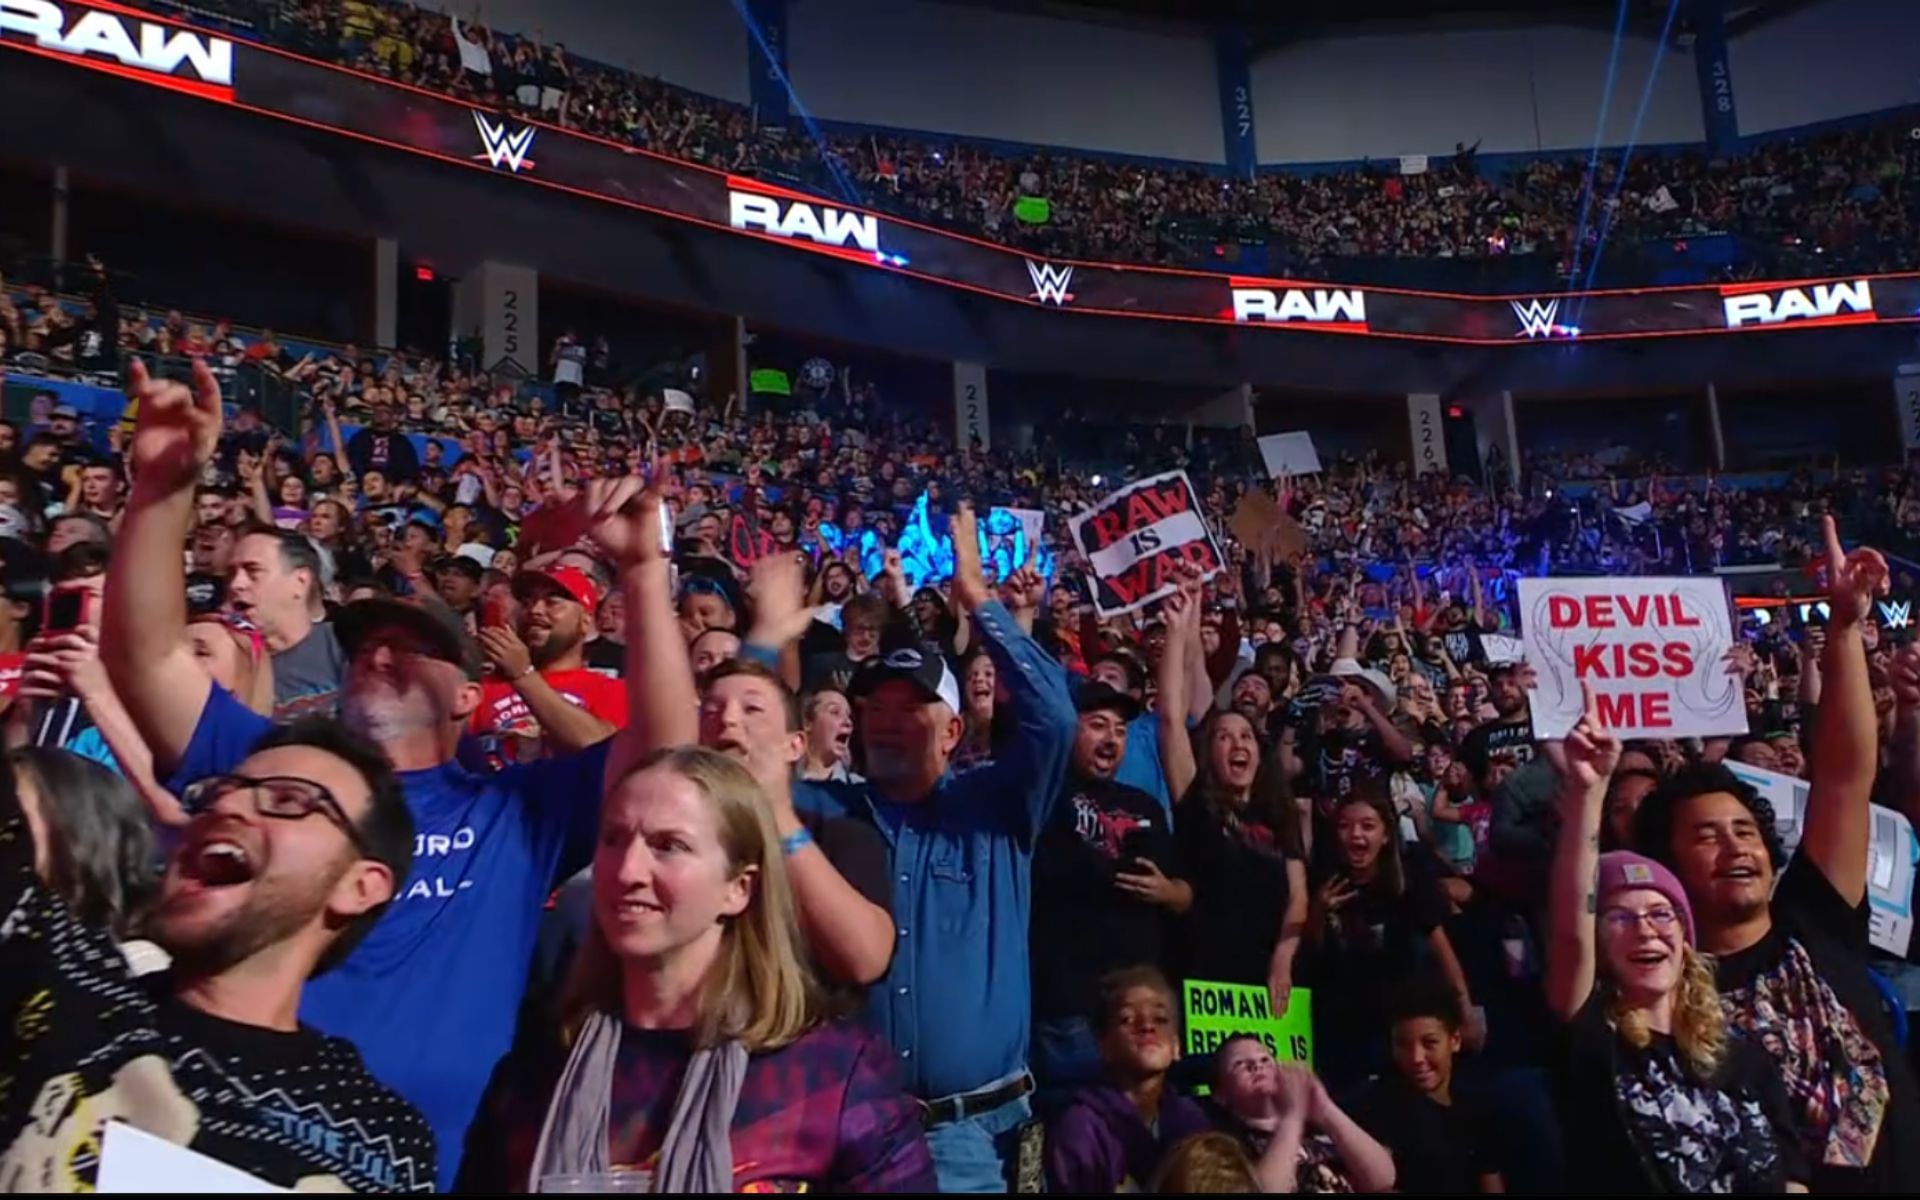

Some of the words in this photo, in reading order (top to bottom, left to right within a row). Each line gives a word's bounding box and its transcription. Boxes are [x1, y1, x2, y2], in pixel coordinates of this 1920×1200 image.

[0, 0, 233, 86] RAW
[1235, 86, 1251, 136] 327
[1712, 61, 1732, 112] 328
[729, 191, 878, 251] RAW
[504, 290, 518, 354] 225
[1232, 289, 1366, 323] RAW
[1722, 279, 1873, 328] RAW
[1420, 410, 1434, 460] 226
[1092, 480, 1188, 549] RAW
[1129, 527, 1162, 556] IS
[1105, 540, 1219, 604] WAR
[1549, 595, 1700, 630] DEVIL
[1574, 641, 1694, 678] KISS
[1596, 692, 1673, 728] ME
[1190, 987, 1268, 1020] ROMAN
[1289, 1034, 1307, 1060] IS
